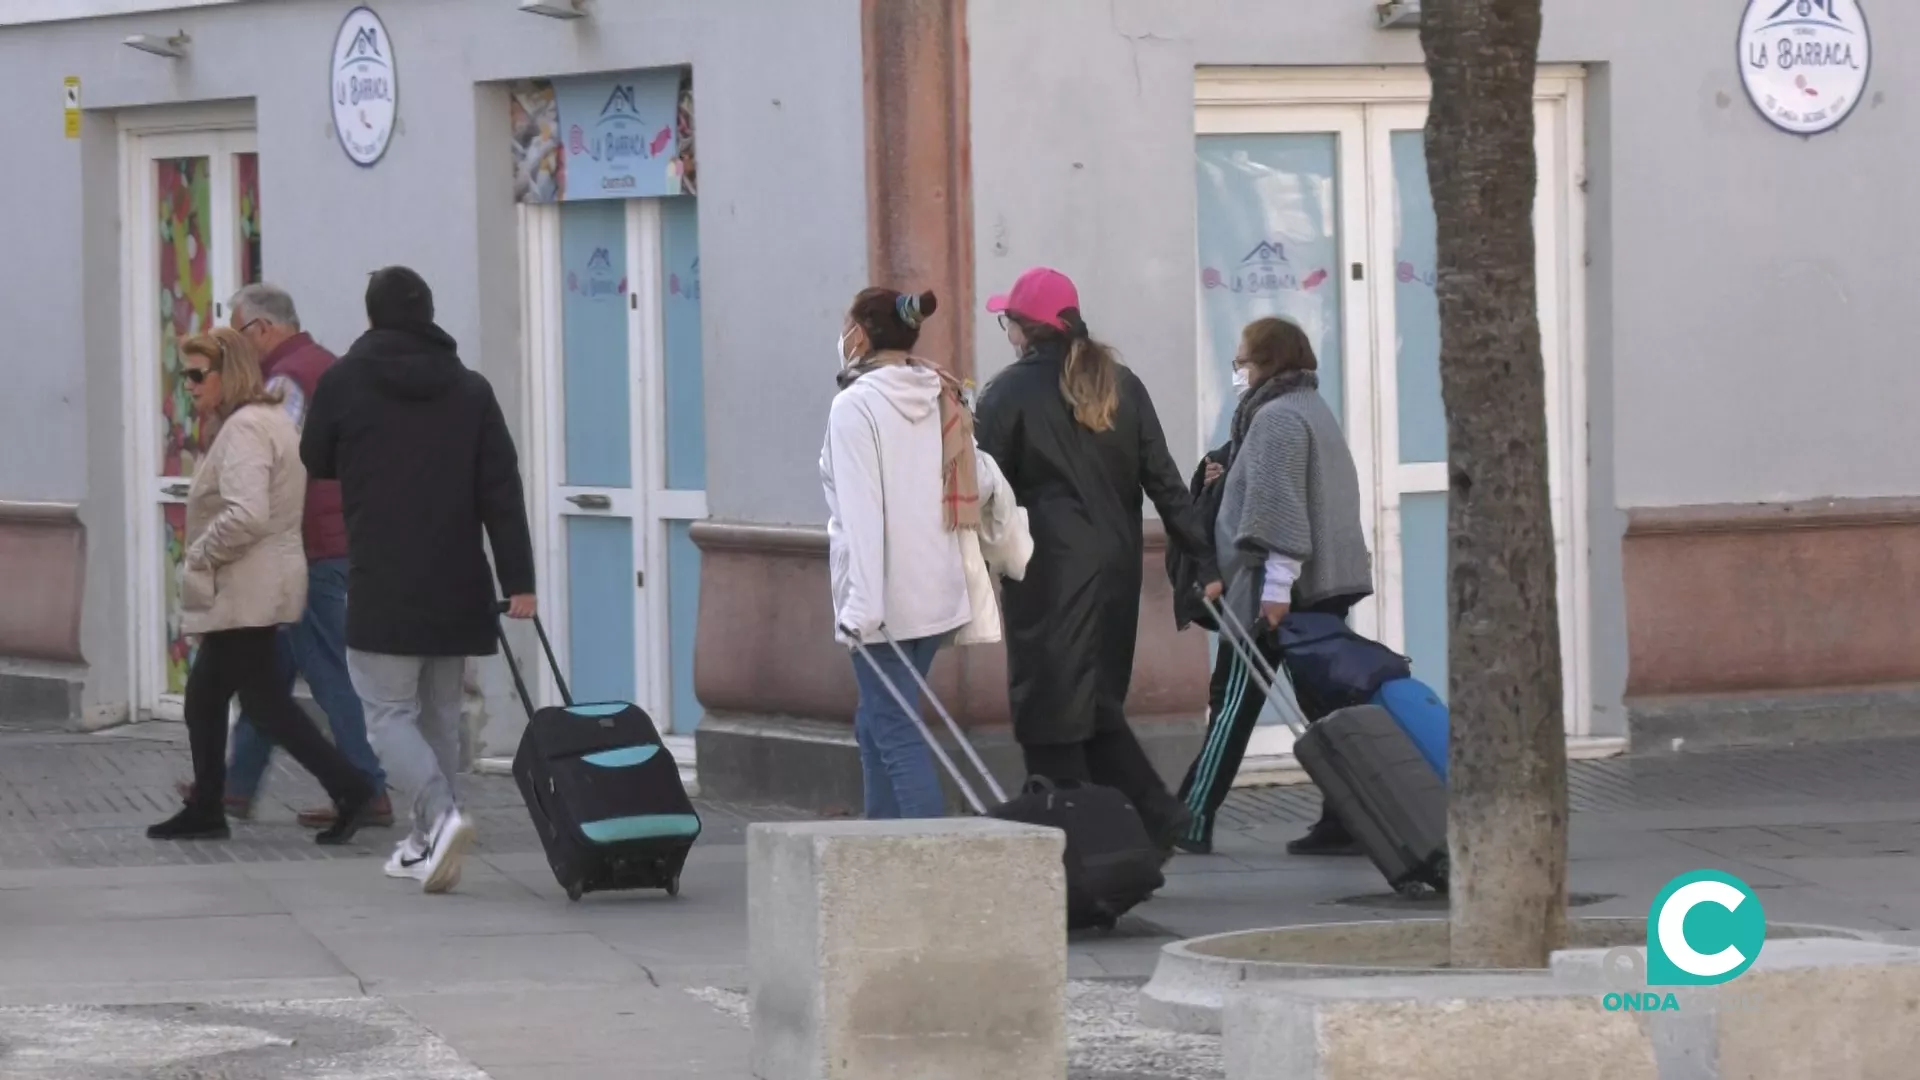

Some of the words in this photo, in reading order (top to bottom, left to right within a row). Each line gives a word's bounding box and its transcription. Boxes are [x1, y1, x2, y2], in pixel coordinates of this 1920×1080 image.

[1749, 42, 1768, 69] LA
[1777, 37, 1859, 69] BARRACA
[351, 75, 393, 106] BARRACA
